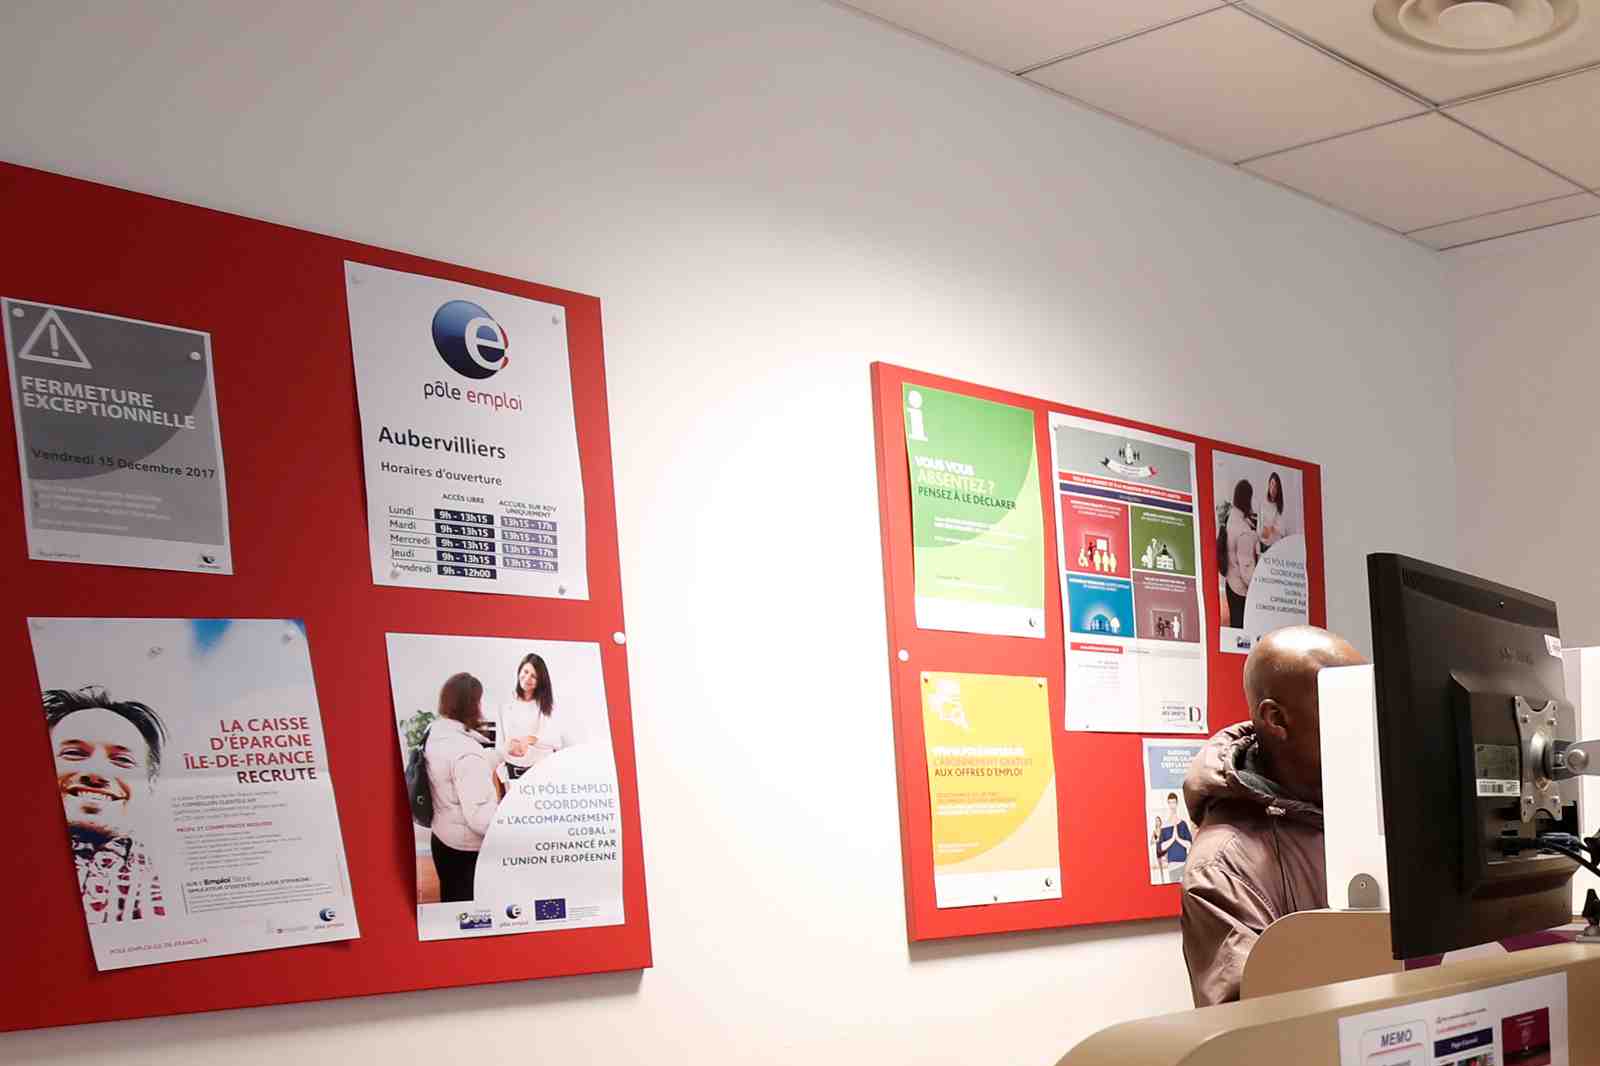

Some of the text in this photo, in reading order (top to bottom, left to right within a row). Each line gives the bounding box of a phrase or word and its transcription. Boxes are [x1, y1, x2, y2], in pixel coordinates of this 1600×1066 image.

[21, 375, 154, 409] FERMETURE
[423, 380, 523, 412] pôle emploi
[22, 392, 197, 430] EXCEPTIONNELLE
[378, 425, 507, 460] Aubervilliers
[31, 447, 94, 466] Vendredi
[98, 456, 115, 467] 15
[185, 466, 216, 479] 2017
[380, 460, 502, 486] Horaires d'ouverture
[918, 486, 953, 501] PENSEZ
[962, 494, 972, 503] LE
[389, 505, 415, 516] Lundi
[460, 512, 488, 522] 13h15
[389, 519, 416, 530] Mardi
[440, 524, 453, 534] 9h
[462, 526, 489, 537] 13h15
[390, 534, 431, 545] Mercredi
[462, 540, 489, 551] 13h15
[391, 548, 415, 559] Jeudi
[442, 552, 454, 562] 9h
[463, 554, 490, 565] 13h15
[442, 566, 455, 576] 9h
[464, 568, 491, 578] 12h00
[220, 716, 310, 733] LA CAISSE
[210, 733, 312, 751] D'ÉPARGNE
[236, 767, 318, 784] RECRUTE
[935, 767, 954, 776] AUX
[955, 767, 985, 776] OFFRES
[571, 783, 612, 794] EMPLOI
[534, 798, 615, 810] COORDONNE
[507, 813, 615, 825] L'ACCOMPAGNEMENT
[568, 826, 606, 837] GLOBAL
[598, 839, 617, 848] PAR
[502, 855, 547, 866] L'UNION
